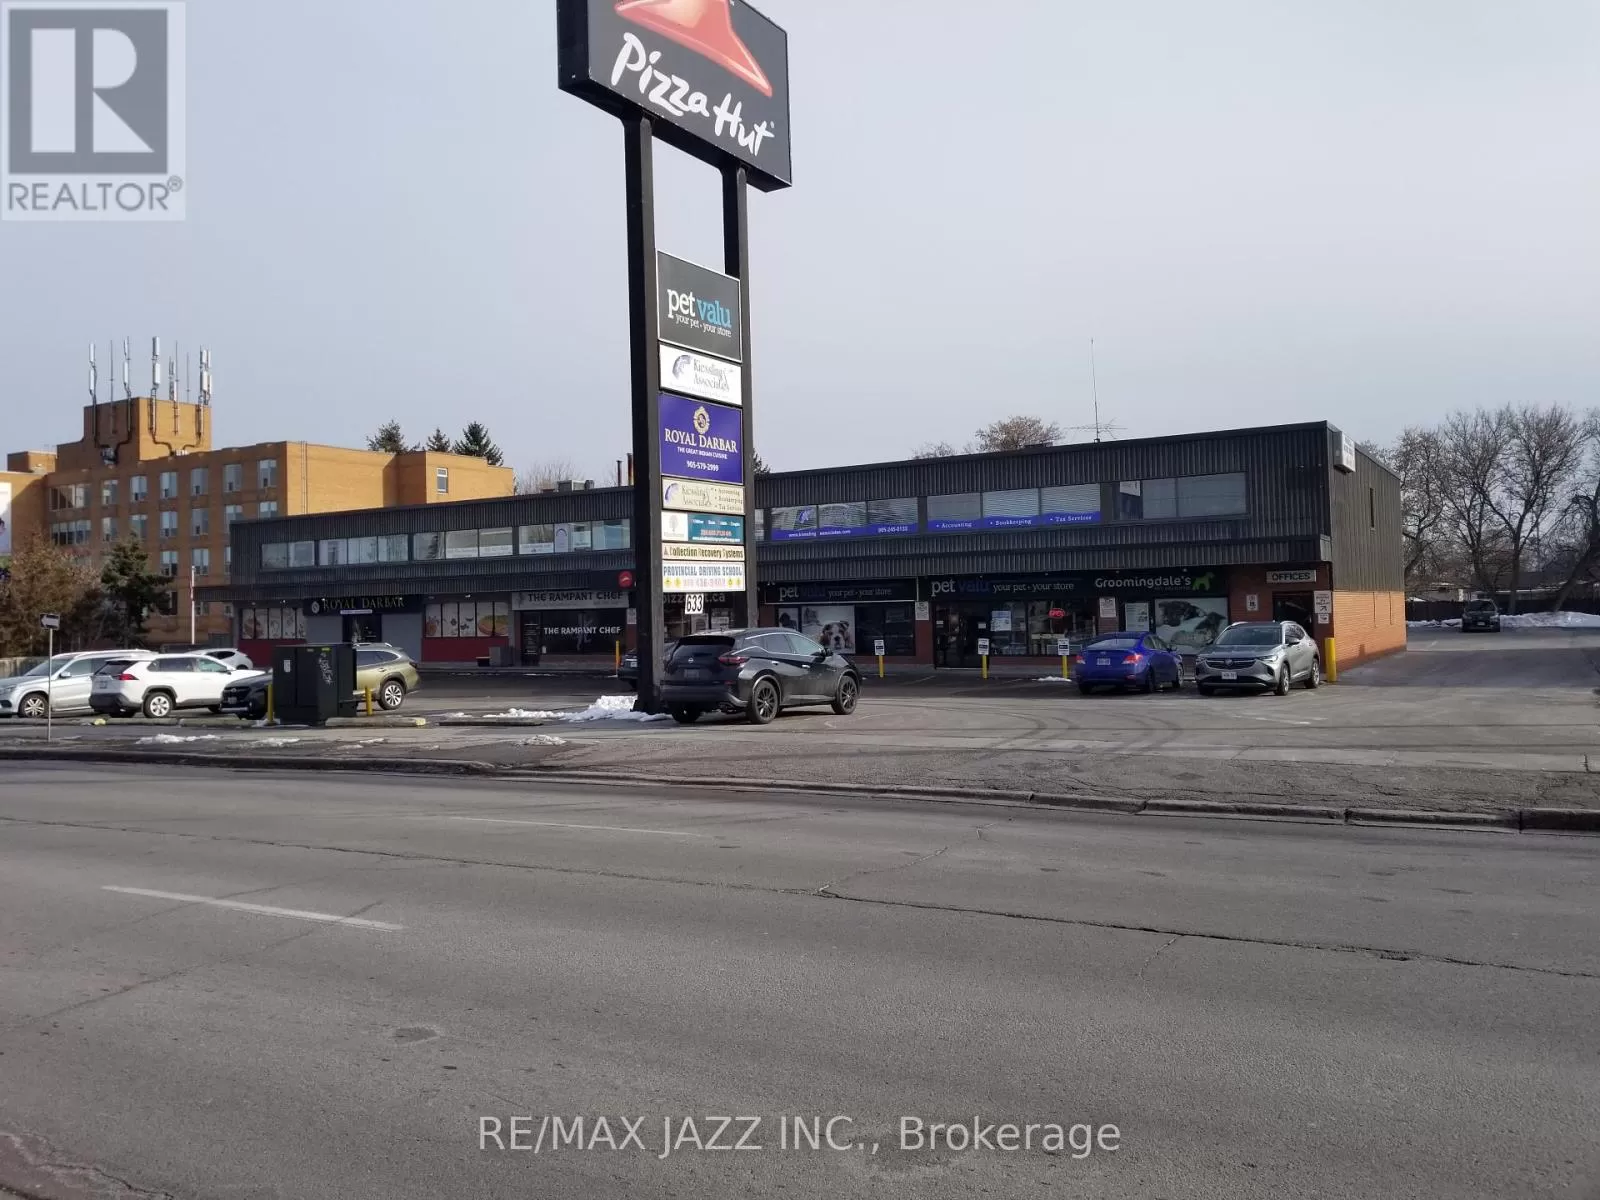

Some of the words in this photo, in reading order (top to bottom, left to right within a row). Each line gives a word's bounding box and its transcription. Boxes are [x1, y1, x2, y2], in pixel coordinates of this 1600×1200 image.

[611, 31, 710, 117] Pizza
[712, 92, 775, 156] Hut
[667, 288, 696, 319] pet
[696, 298, 732, 329] valu
[675, 313, 690, 325] your
[690, 318, 700, 329] pet
[702, 322, 717, 333] your
[716, 327, 732, 338] store
[664, 428, 698, 447] ROYAL
[699, 434, 738, 453] DARBAR
[677, 446, 686, 454] THE
[685, 447, 699, 456] GREAT
[712, 451, 728, 460] CUISINE
[686, 460, 719, 471] 905-579-2999
[995, 518, 1032, 526] Bookkeeping
[669, 546, 697, 557] Collection
[698, 548, 722, 559] Recovery
[723, 549, 744, 559] Systems
[663, 565, 698, 576] PROVINCIAL
[699, 566, 721, 576] DRIVING
[722, 566, 743, 576] SCHOOL
[1271, 571, 1311, 581] OFFICES
[931, 579, 956, 597] pet
[959, 578, 991, 593] valu
[992, 582, 1011, 594] your
[1012, 582, 1027, 593] pet
[1031, 582, 1052, 593] your
[1053, 581, 1074, 591] store
[1094, 575, 1192, 591] Groomingdale's
[528, 593, 547, 602] THE
[549, 591, 593, 602] RAMPANT
[596, 590, 624, 600] CHEF
[779, 586, 799, 601] pet
[323, 597, 356, 612] ROYAL
[362, 596, 405, 609] DARBAR
[687, 595, 703, 612] 633
[543, 627, 560, 635] THE
[560, 626, 597, 635] RAMPANT
[599, 626, 622, 634] CHEF
